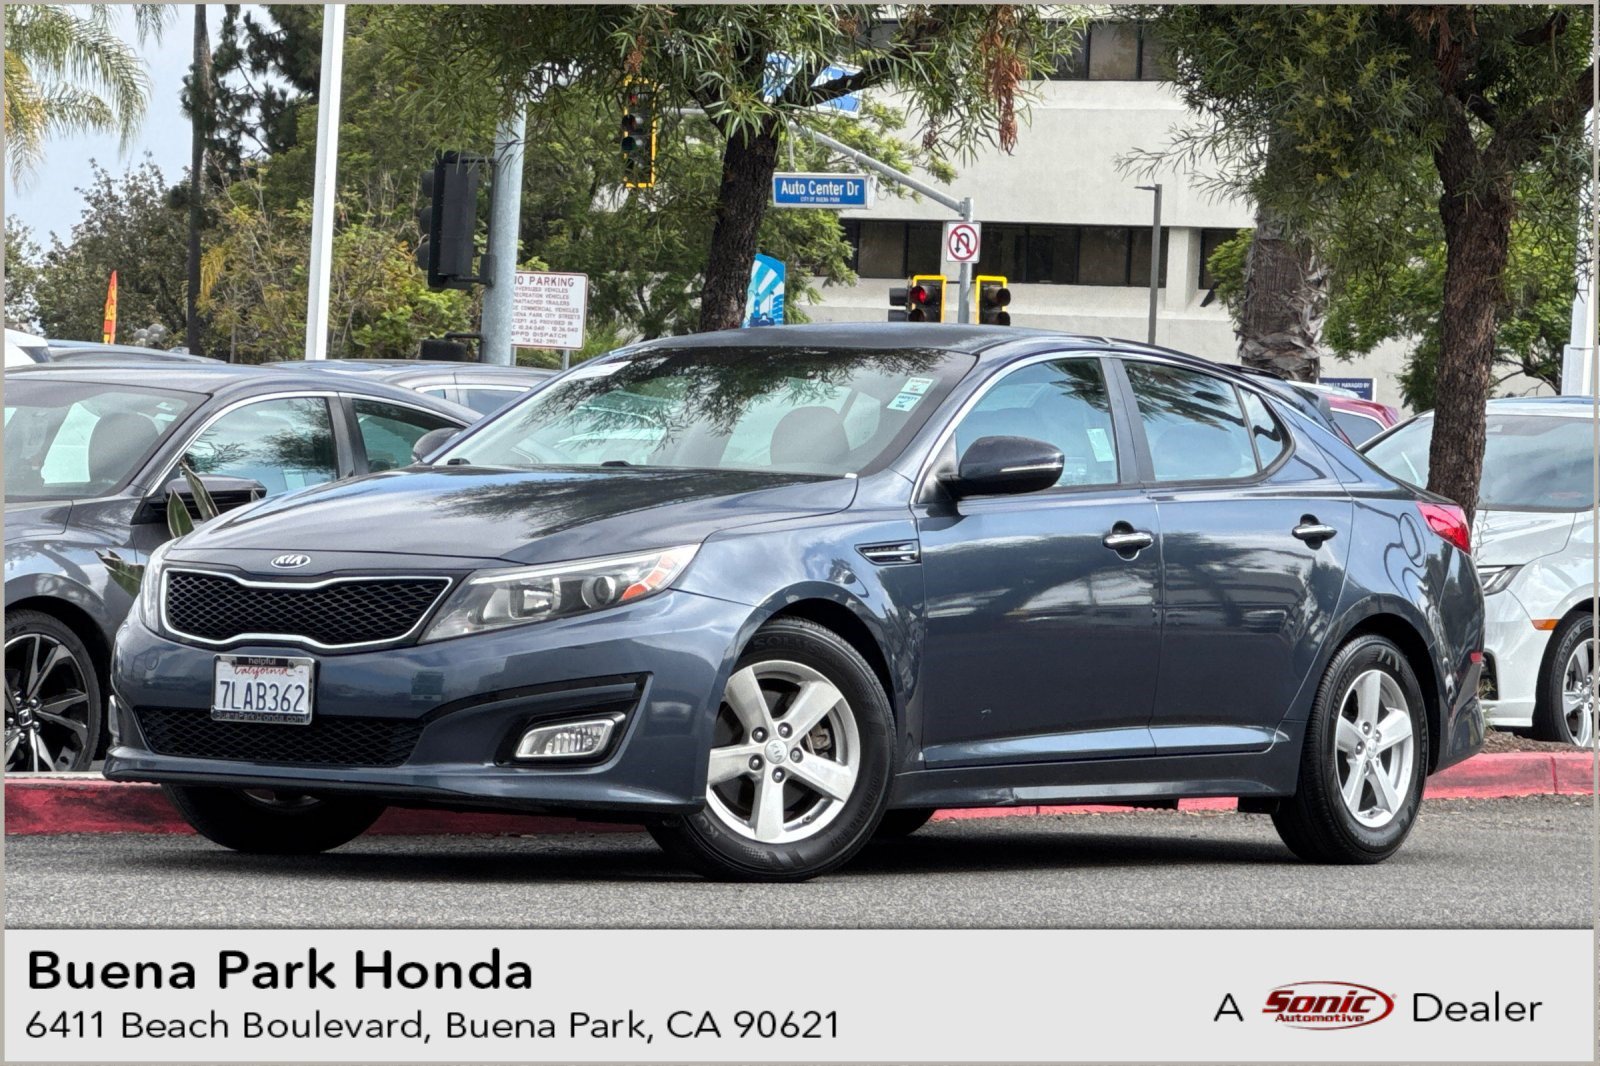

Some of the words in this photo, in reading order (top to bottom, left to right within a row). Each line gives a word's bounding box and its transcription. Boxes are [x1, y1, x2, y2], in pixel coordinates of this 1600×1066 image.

[781, 180, 805, 195] Auto
[808, 180, 844, 195] Center
[846, 181, 859, 196] Dr
[529, 276, 574, 287] PARKING
[274, 554, 305, 566] KIA
[248, 657, 276, 666] helpful
[235, 665, 295, 679] California
[220, 680, 305, 713] 7LAB362
